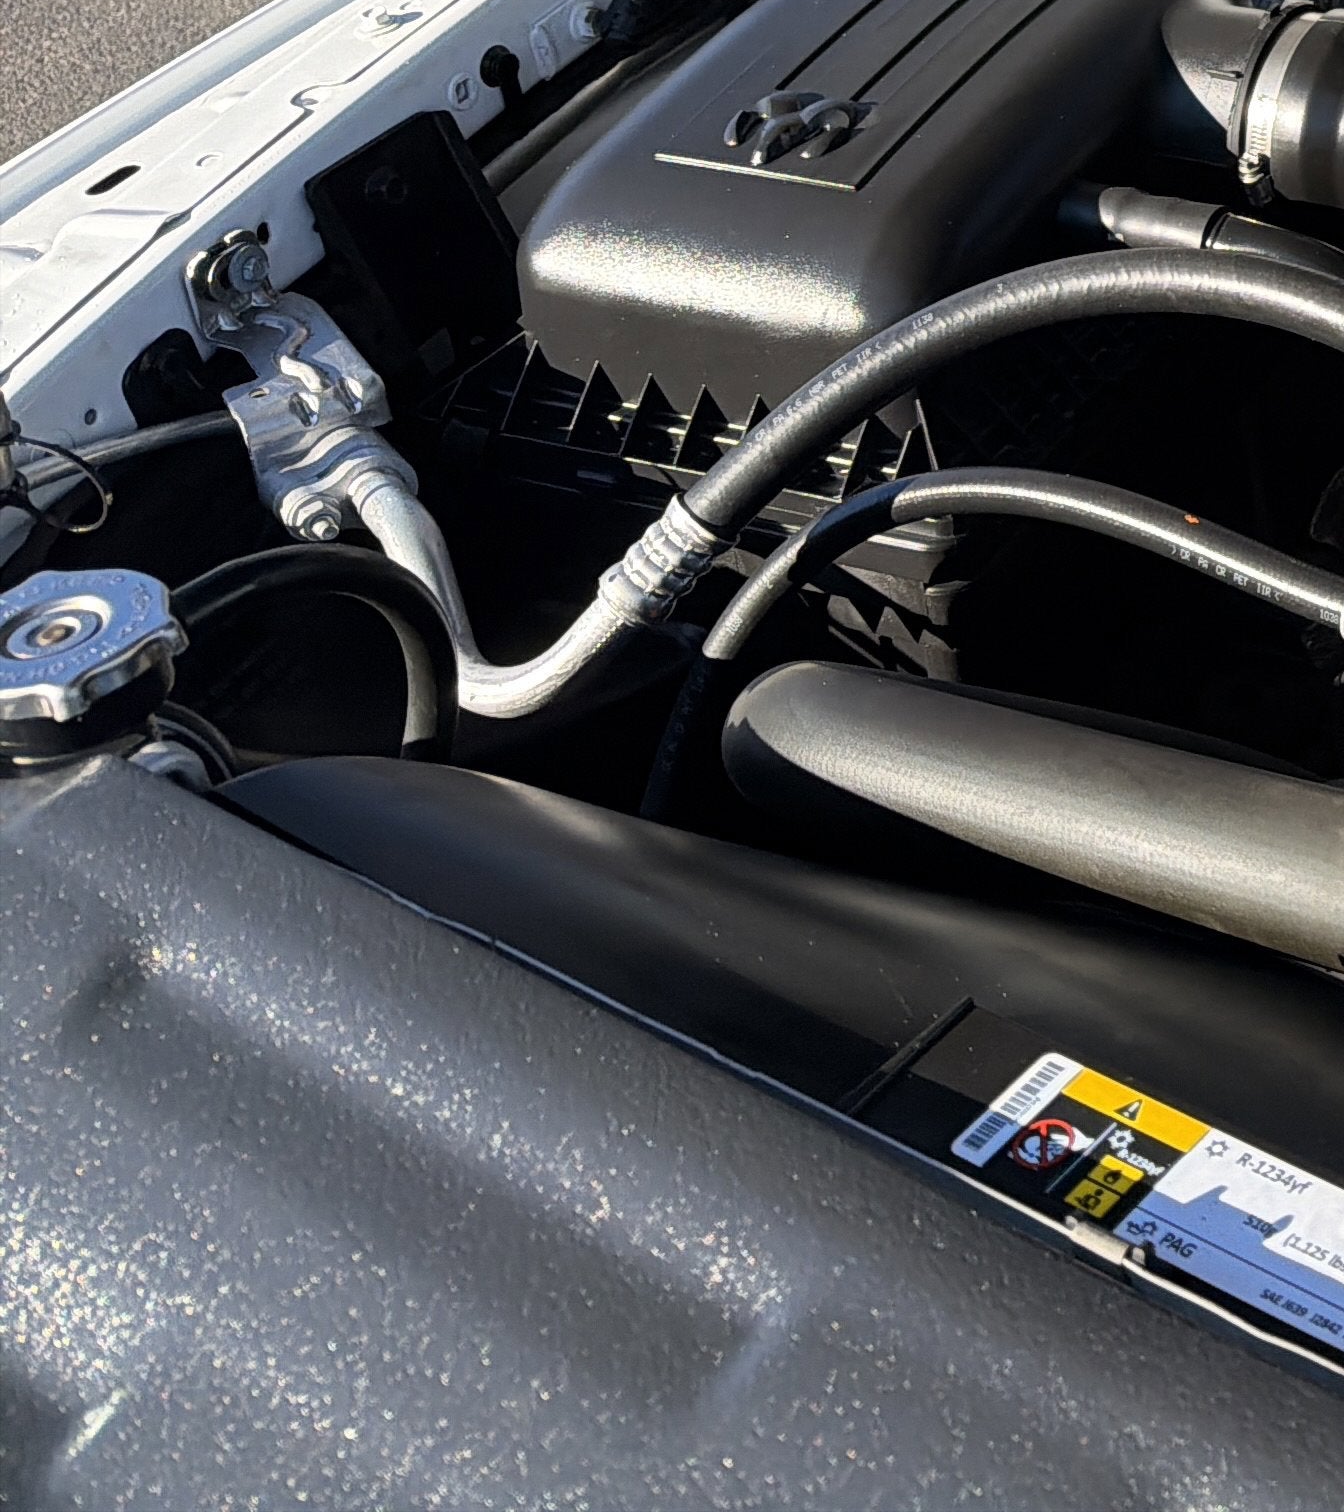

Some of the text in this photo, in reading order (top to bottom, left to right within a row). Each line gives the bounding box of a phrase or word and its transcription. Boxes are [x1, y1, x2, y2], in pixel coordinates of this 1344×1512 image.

[1233, 573, 1249, 587] PET
[1235, 1151, 1314, 1196] R-1234yf
[1158, 1231, 1198, 1258] PAG
[1259, 1289, 1284, 1306] SAE
